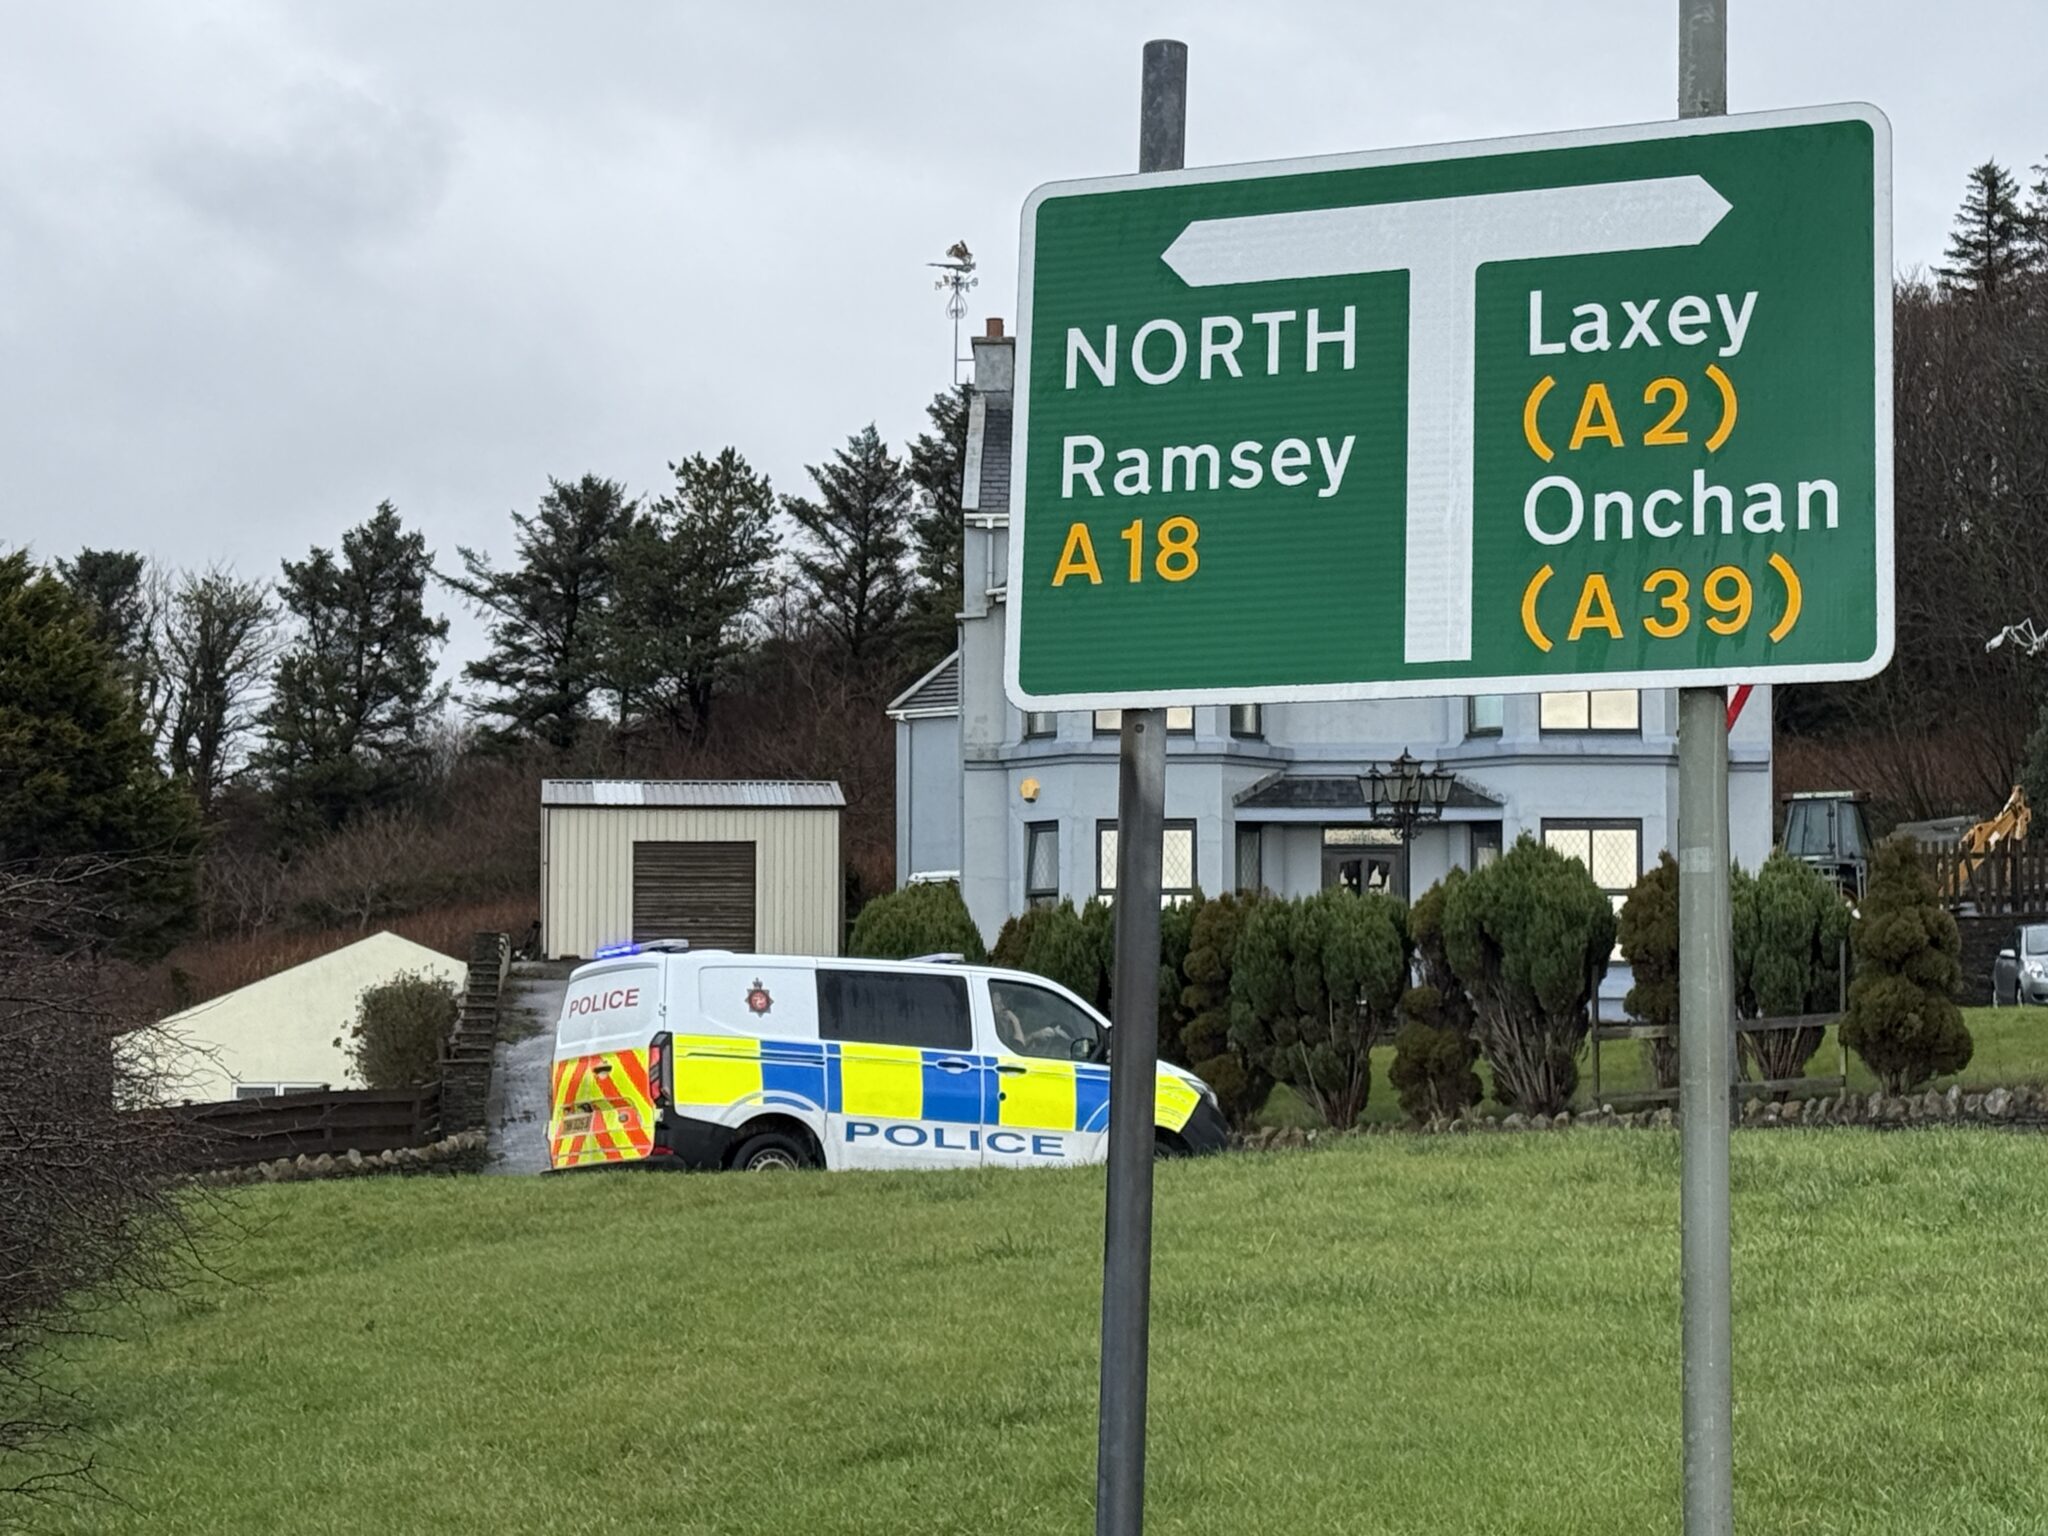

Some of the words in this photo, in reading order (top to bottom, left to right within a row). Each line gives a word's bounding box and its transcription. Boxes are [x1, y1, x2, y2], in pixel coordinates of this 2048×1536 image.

[1065, 306, 1356, 390] NORTH
[1529, 290, 1759, 357] Laxey
[1061, 435, 1356, 498] Ramsey
[1523, 468, 1839, 545] Onchan
[568, 988, 640, 1018] POLICE
[845, 1121, 1065, 1157] POLICE
